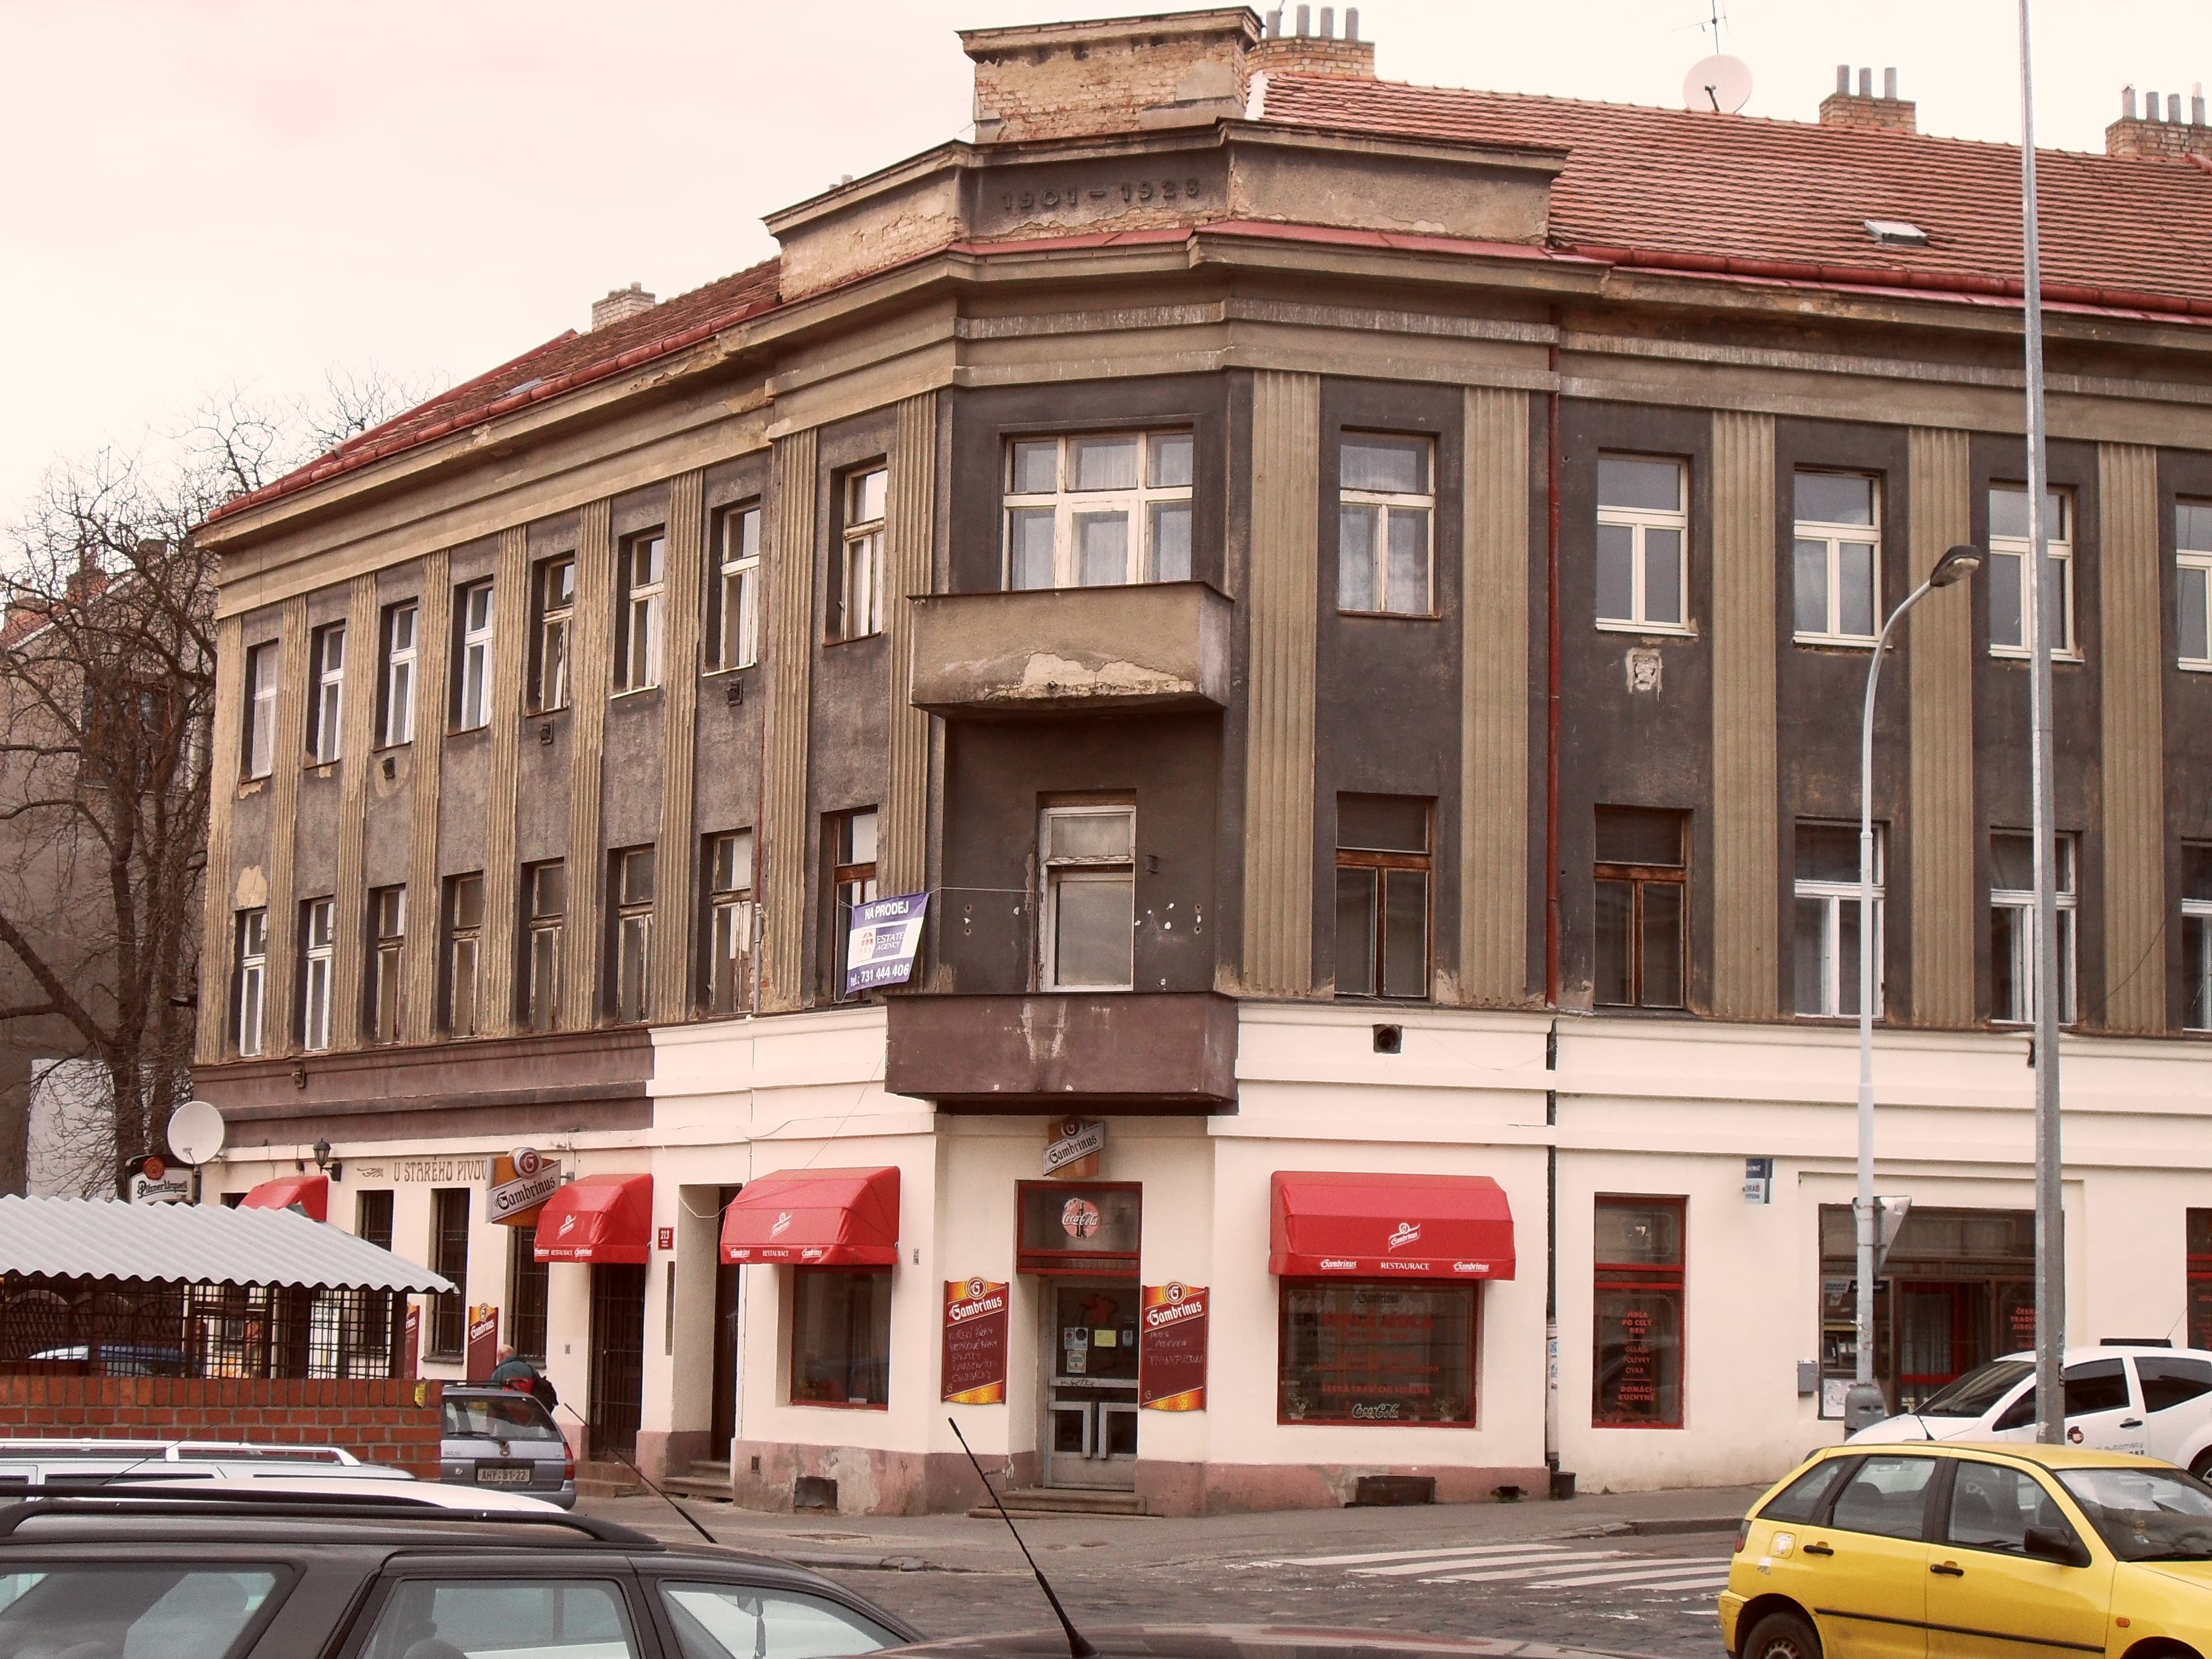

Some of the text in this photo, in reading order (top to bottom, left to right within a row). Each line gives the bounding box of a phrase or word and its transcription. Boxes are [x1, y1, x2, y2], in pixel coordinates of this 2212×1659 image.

[865, 900, 909, 920] NA PRODEJ
[876, 941, 902, 951] AGENCY
[877, 931, 905, 944] ESTATE
[861, 970, 874, 983] 731
[876, 967, 891, 980] 444
[892, 964, 910, 976] 406
[1048, 1134, 1097, 1164] Gambrinus
[394, 1162, 400, 1182] U
[404, 1156, 453, 1182] STARÉHO
[137, 1179, 188, 1199] Pilsner Urquell
[494, 1176, 556, 1210] Gambrinus
[660, 1230, 670, 1240] 213
[1390, 1231, 1418, 1246] Gambrinus
[1319, 1258, 1490, 1273] Gambrinus RESTAURACE Gambrinus
[948, 1296, 1002, 1321] Gambrinus
[1146, 1301, 1202, 1326] Gambrinus
[1352, 1403, 1400, 1419] Coca-Cola
